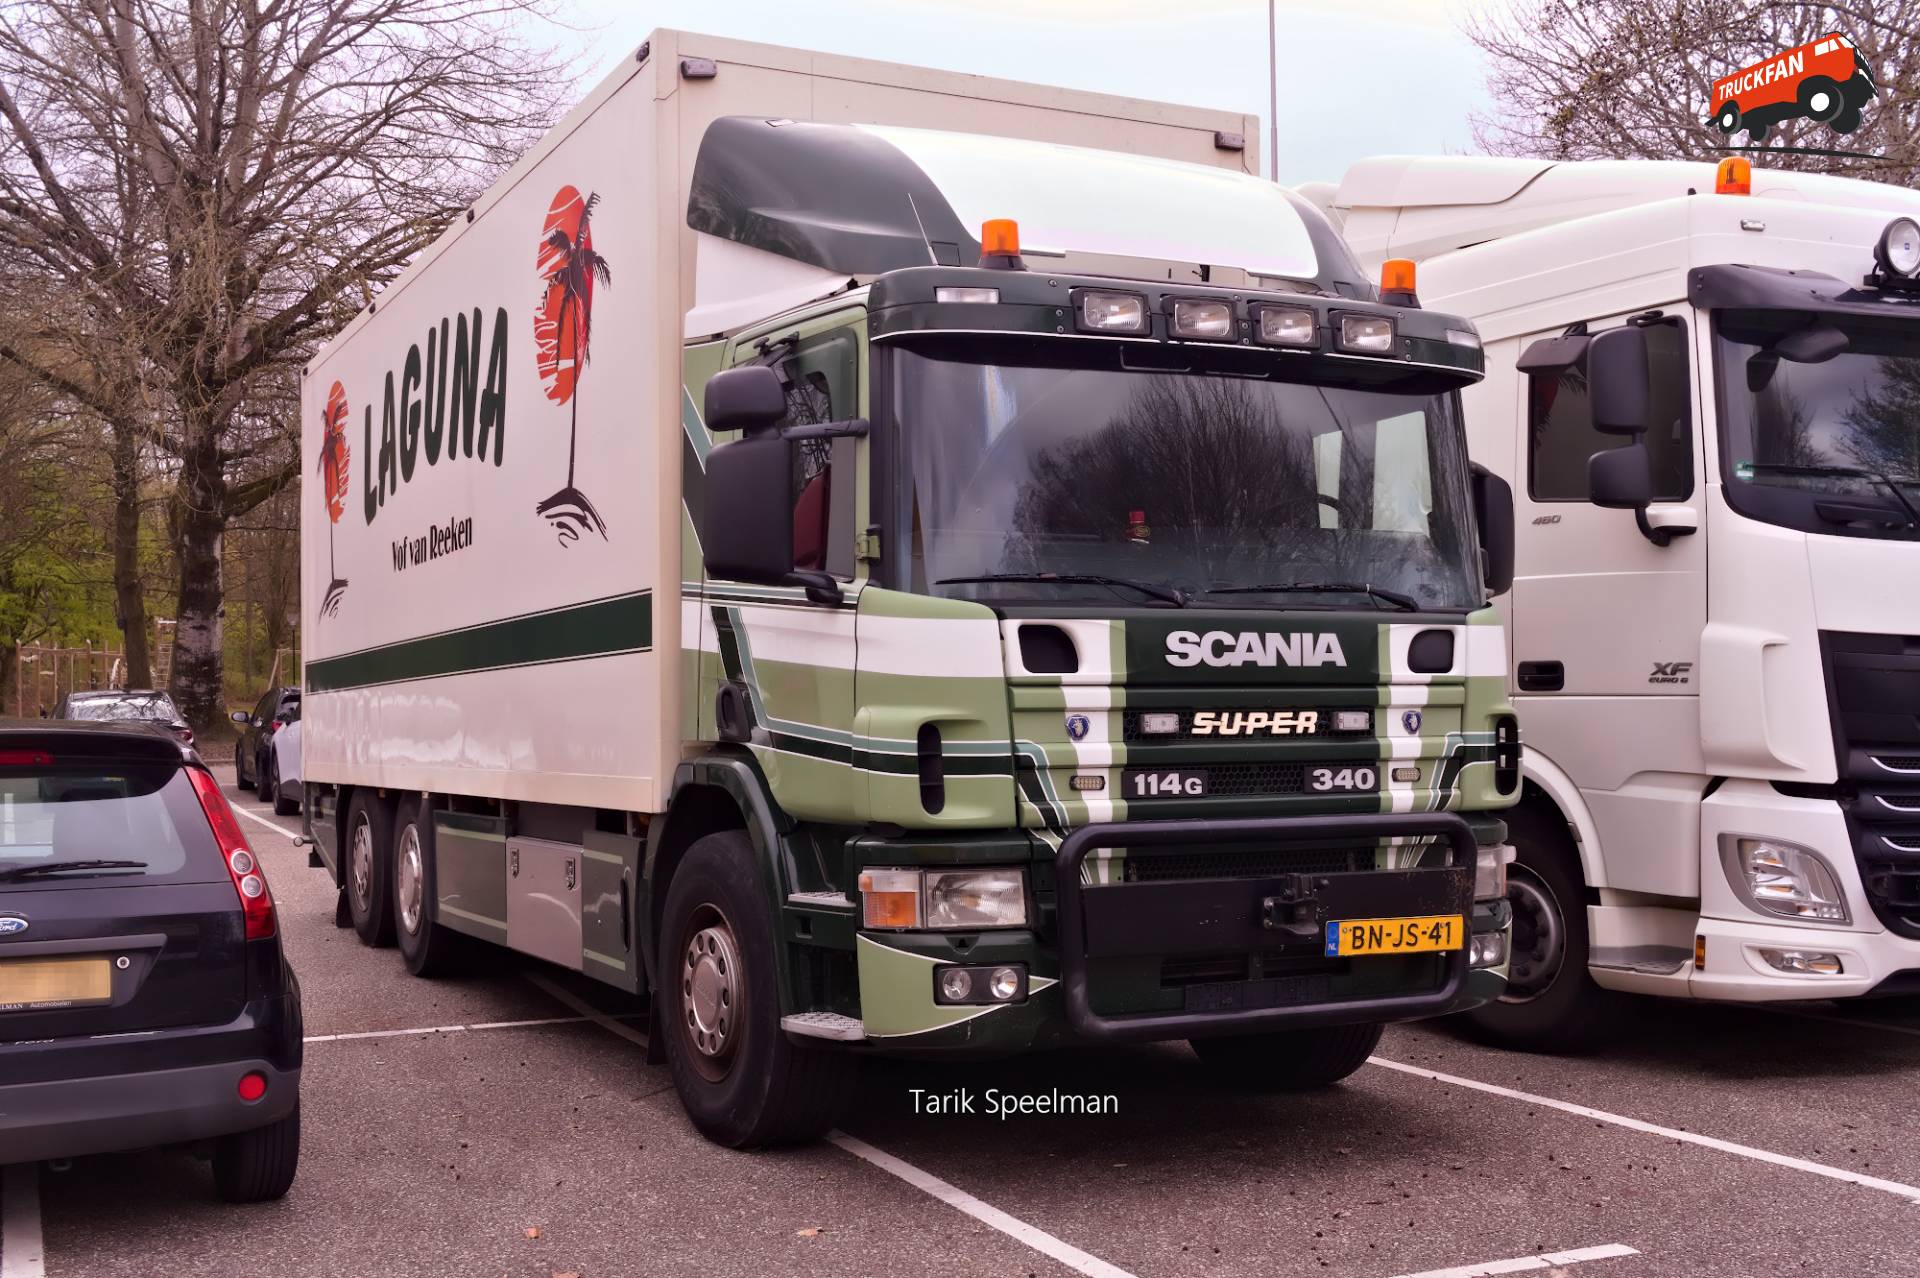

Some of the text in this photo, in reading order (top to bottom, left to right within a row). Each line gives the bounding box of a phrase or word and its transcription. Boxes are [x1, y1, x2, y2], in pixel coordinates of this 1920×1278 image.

[364, 307, 508, 526] LAGUNA
[1532, 514, 1562, 525] 460
[409, 536, 427, 566] van
[429, 516, 472, 560] Reeken
[1165, 630, 1347, 668] SCANIA
[1650, 662, 1693, 676] XF
[1191, 711, 1318, 736] SUPER
[1312, 768, 1375, 791] 340
[0, 920, 18, 932] ord
[1352, 921, 1452, 950] BN-JS-41
[1327, 943, 1337, 951] NL
